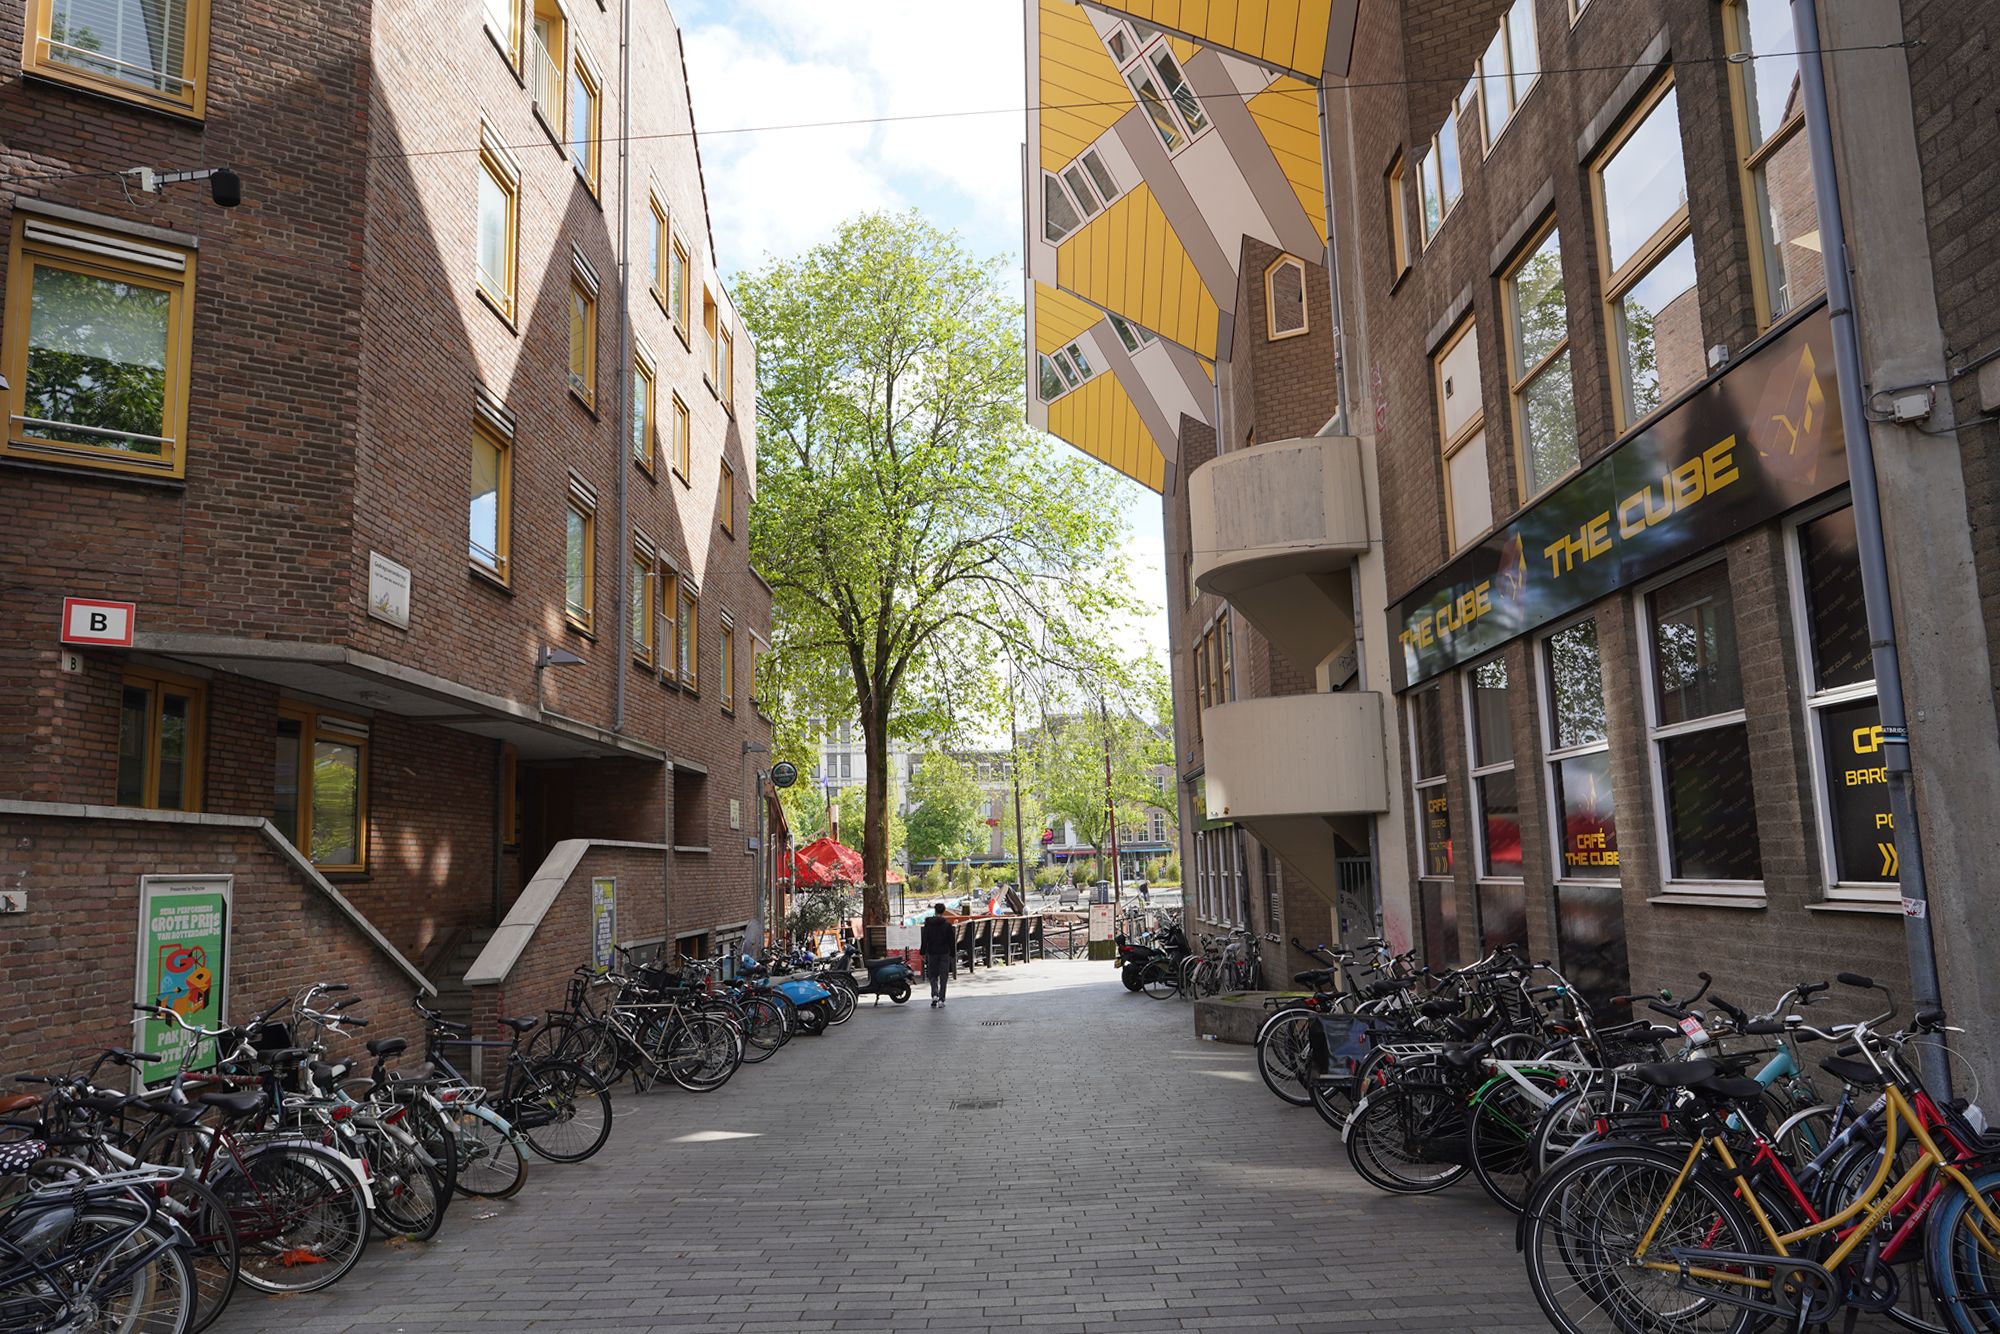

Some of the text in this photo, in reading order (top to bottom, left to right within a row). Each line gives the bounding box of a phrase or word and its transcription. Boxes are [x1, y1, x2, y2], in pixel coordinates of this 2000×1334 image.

[1543, 433, 1740, 579] THE CUBE
[90, 612, 107, 632] B
[1398, 579, 1492, 657] THE CUBE
[70, 656, 77, 671] B
[1428, 793, 1447, 813] CAFÉ
[1577, 827, 1606, 849] CAFÉ
[1565, 851, 1620, 866] THE CUBE
[151, 912, 220, 934] GROTE PRIJS
[157, 932, 170, 941] VAN
[170, 929, 209, 940] ROTTERDAM
[157, 1030, 178, 1047] PAK
